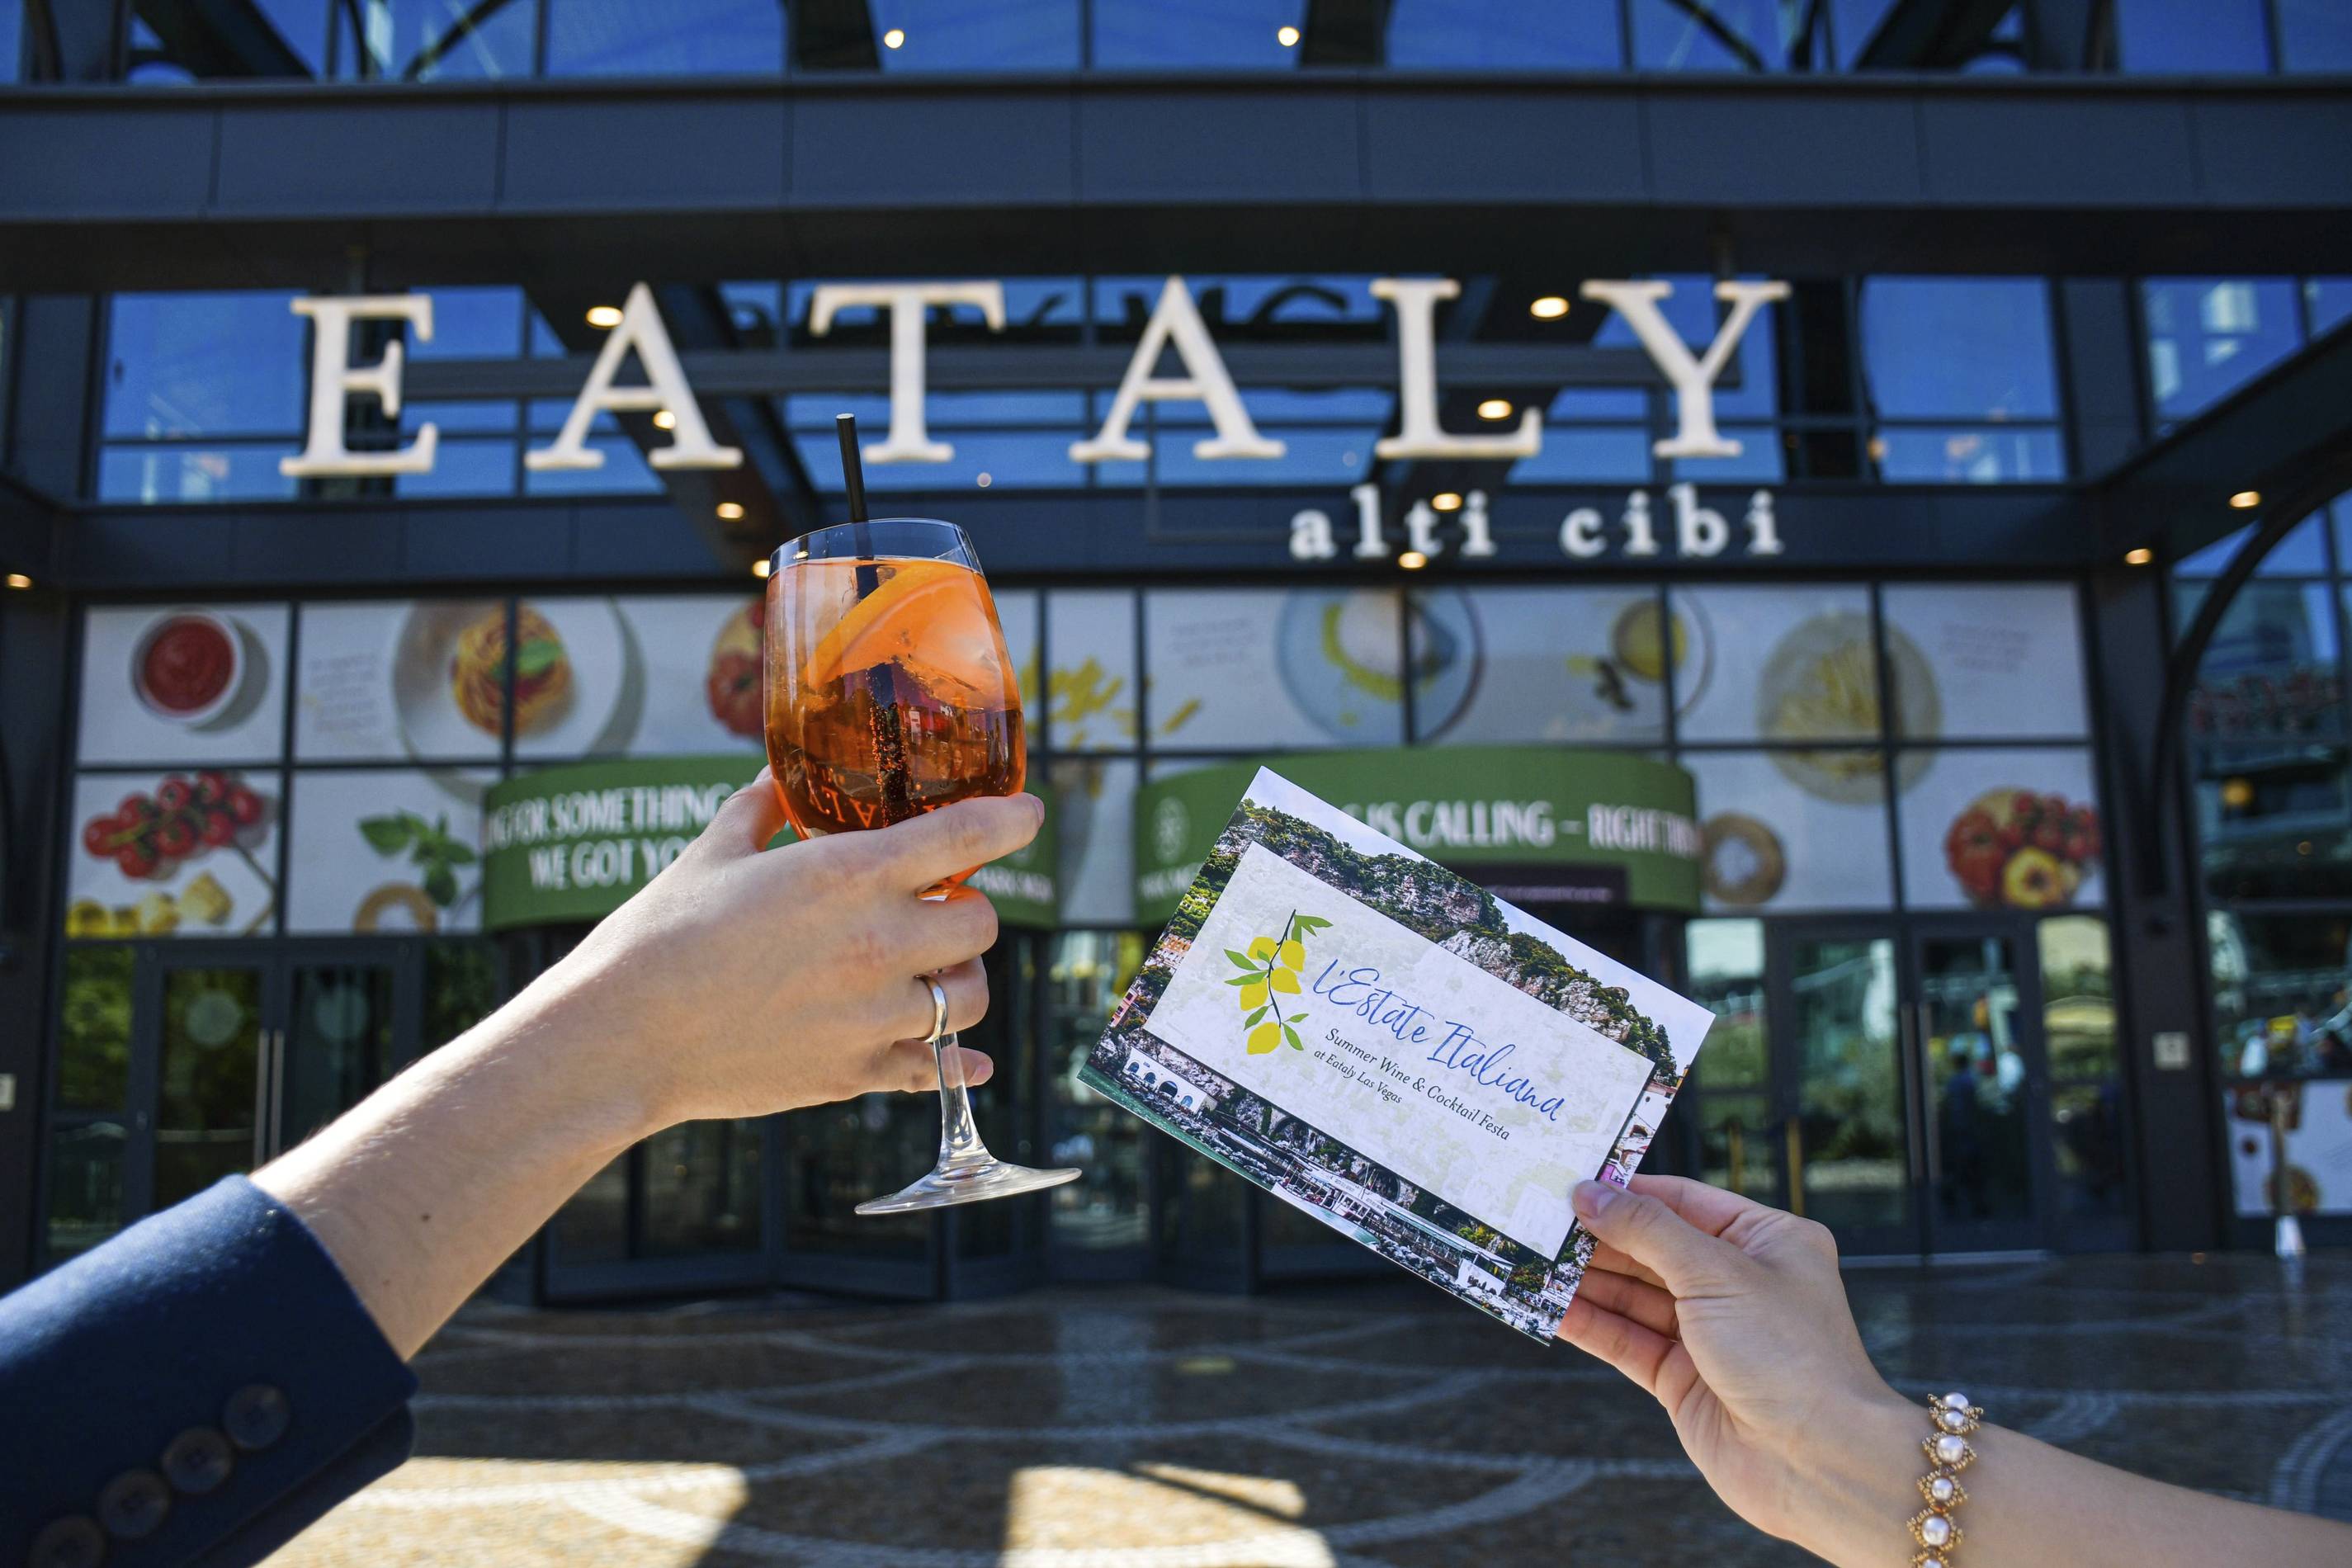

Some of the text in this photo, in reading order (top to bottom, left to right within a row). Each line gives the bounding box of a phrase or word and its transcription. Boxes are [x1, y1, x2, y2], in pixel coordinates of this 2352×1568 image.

[280, 276, 1792, 477] EATALY
[1289, 483, 1783, 560] alti cibi
[528, 835, 693, 891] WE GOT YO
[1404, 800, 1555, 848] CALLING
[1588, 802, 1660, 853] RIGHT
[1314, 1050, 1403, 1103] at Eataly Las Vegas
[1325, 1027, 1510, 1141] Summer Wine & Cocktail Festa
[1427, 1021, 1565, 1121] Italiana
